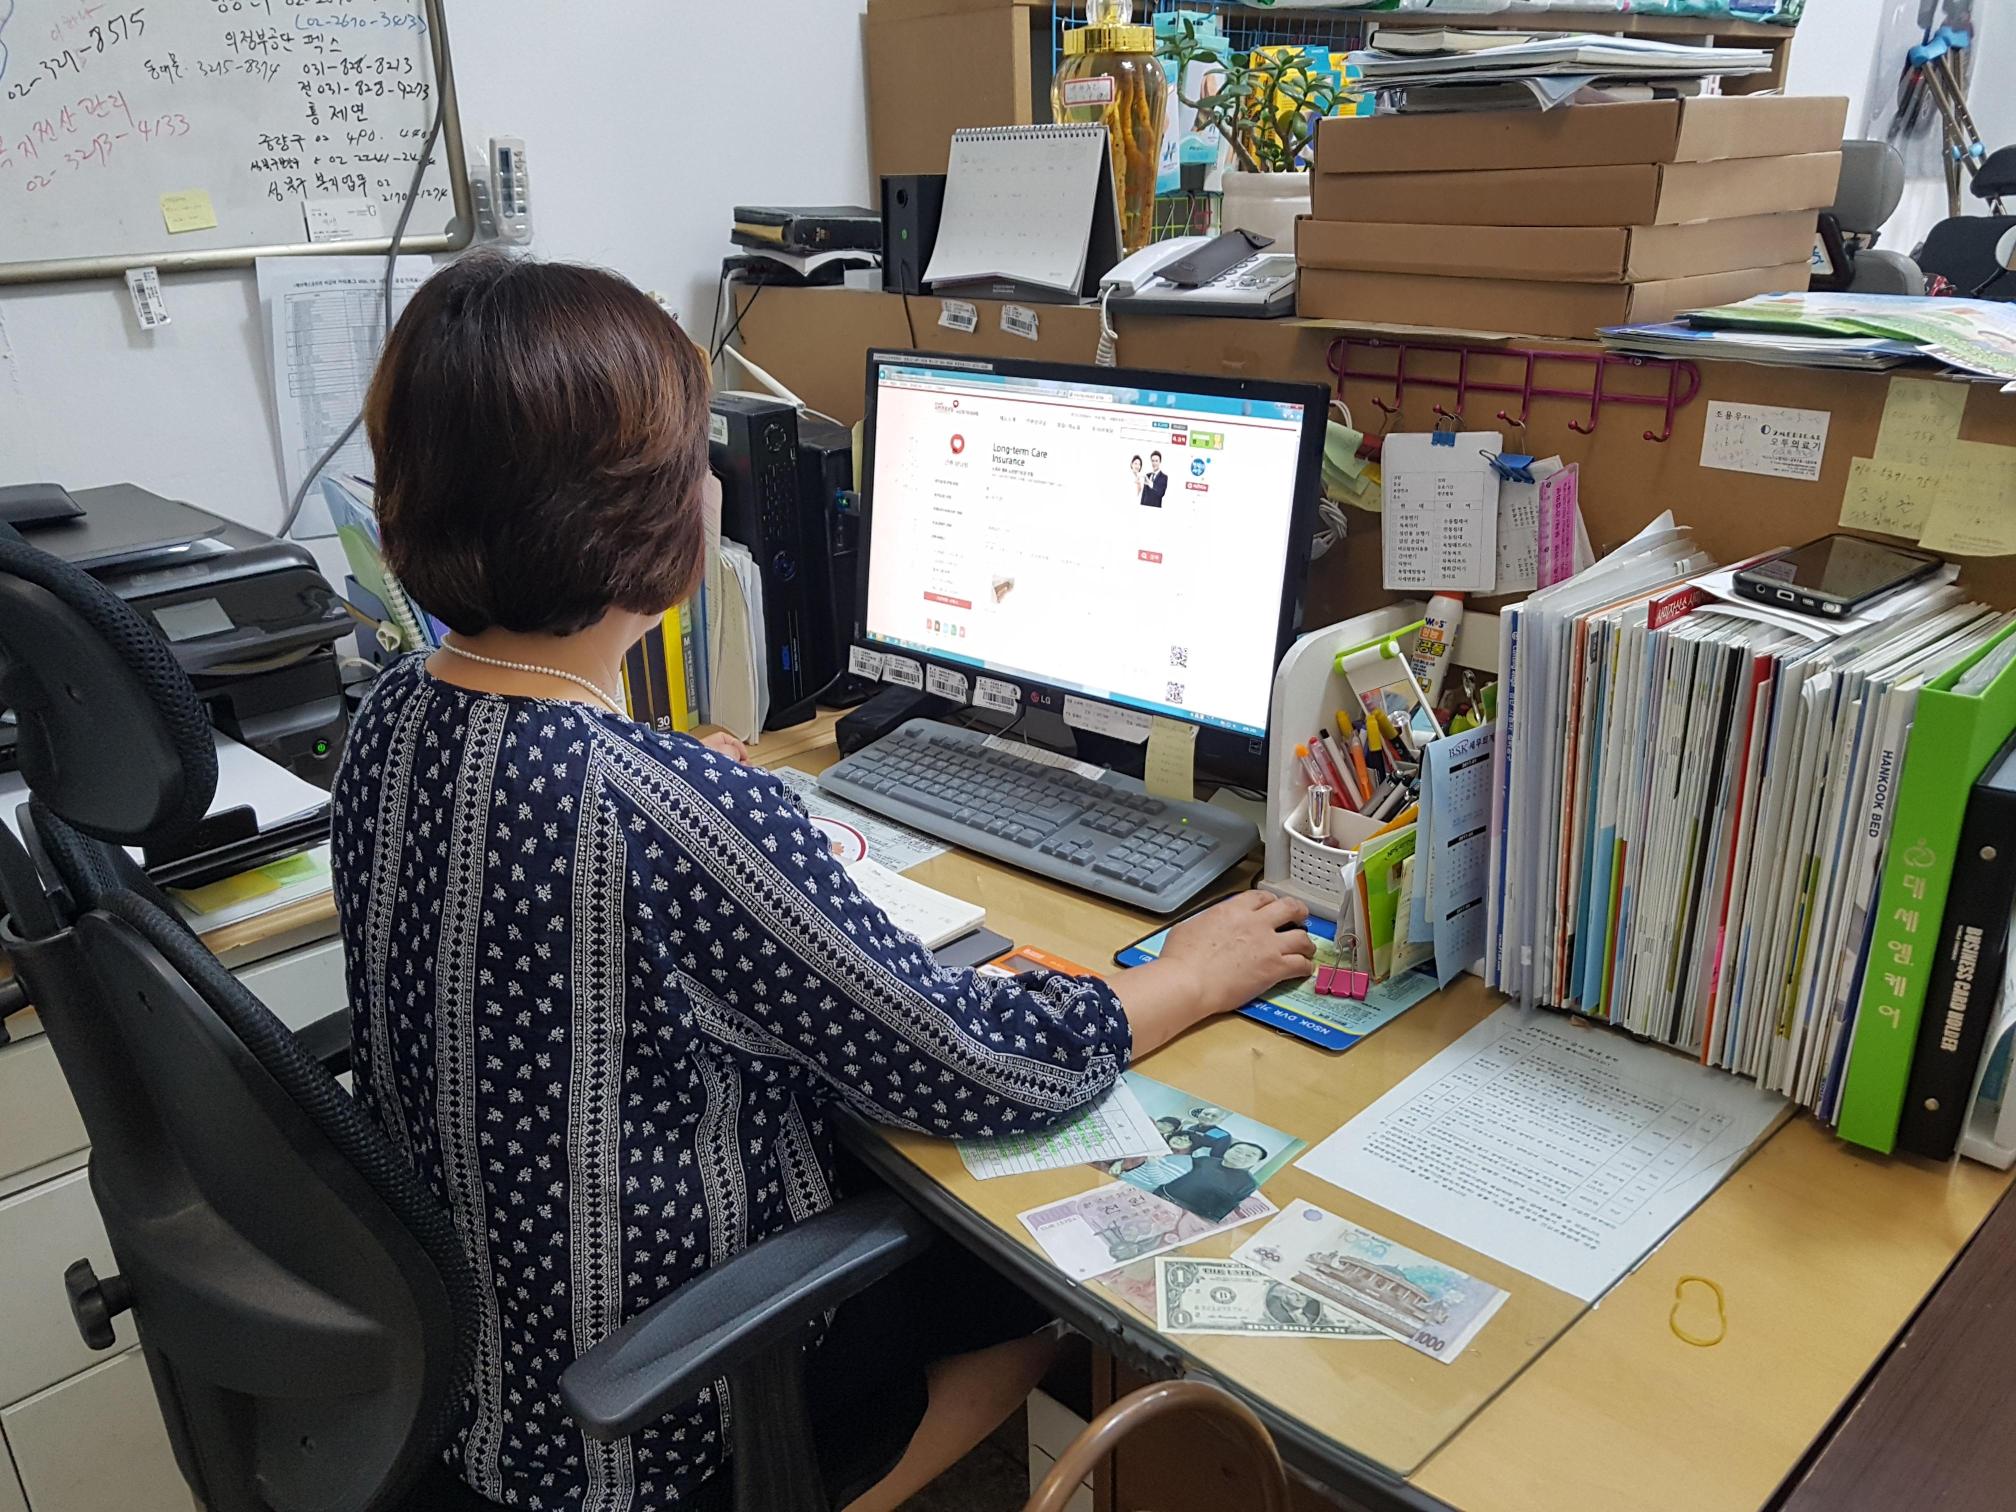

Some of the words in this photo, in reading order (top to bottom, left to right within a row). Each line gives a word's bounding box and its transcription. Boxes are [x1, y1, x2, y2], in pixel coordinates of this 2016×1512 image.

[992, 454, 1025, 467] Insurance
[1040, 694, 1051, 705] LG
[657, 715, 671, 729] 30
[1873, 749, 1894, 811] HANKOOK
[1868, 812, 1882, 838] BED
[1955, 925, 1984, 982] BUSINESS
[1949, 979, 1972, 1012] CARD
[1273, 1008, 1298, 1021] DVR
[1300, 1018, 1331, 1036] NSOK
[1940, 1009, 1965, 1053] HOLDER
[1246, 1323, 1283, 1332] ONE
[1283, 1325, 1347, 1334] DOLLAR
[1414, 1330, 1446, 1352] 1000
